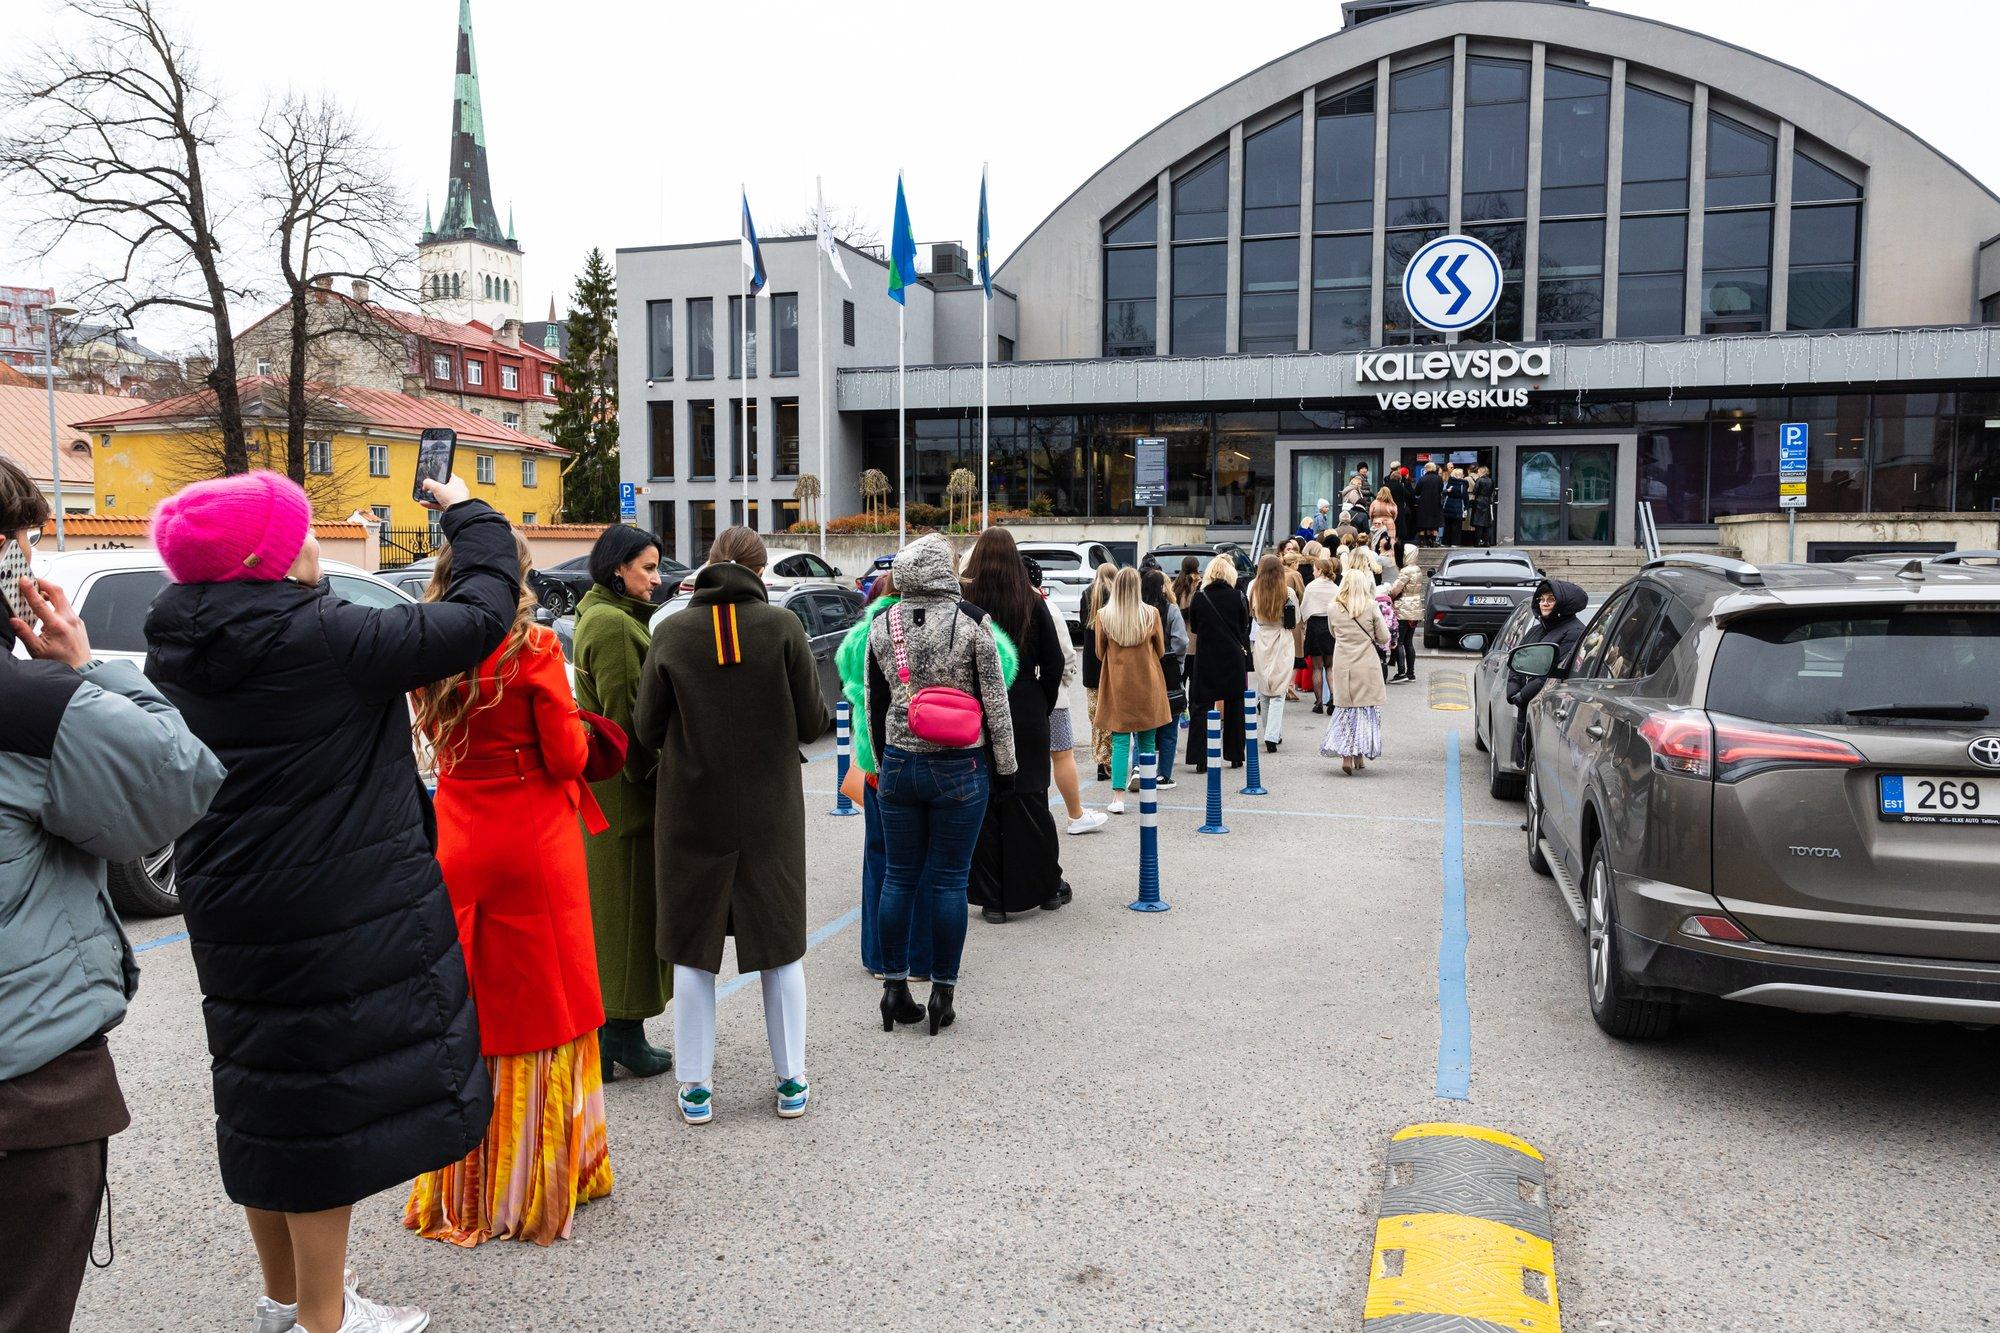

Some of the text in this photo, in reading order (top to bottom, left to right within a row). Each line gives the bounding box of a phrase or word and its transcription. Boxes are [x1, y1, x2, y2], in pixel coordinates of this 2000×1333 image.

[1787, 426, 1802, 446] P
[623, 485, 631, 498] P
[1917, 780, 1980, 810] 269
[1884, 799, 1903, 809] EST
[1788, 846, 1841, 858] TOYOTA
